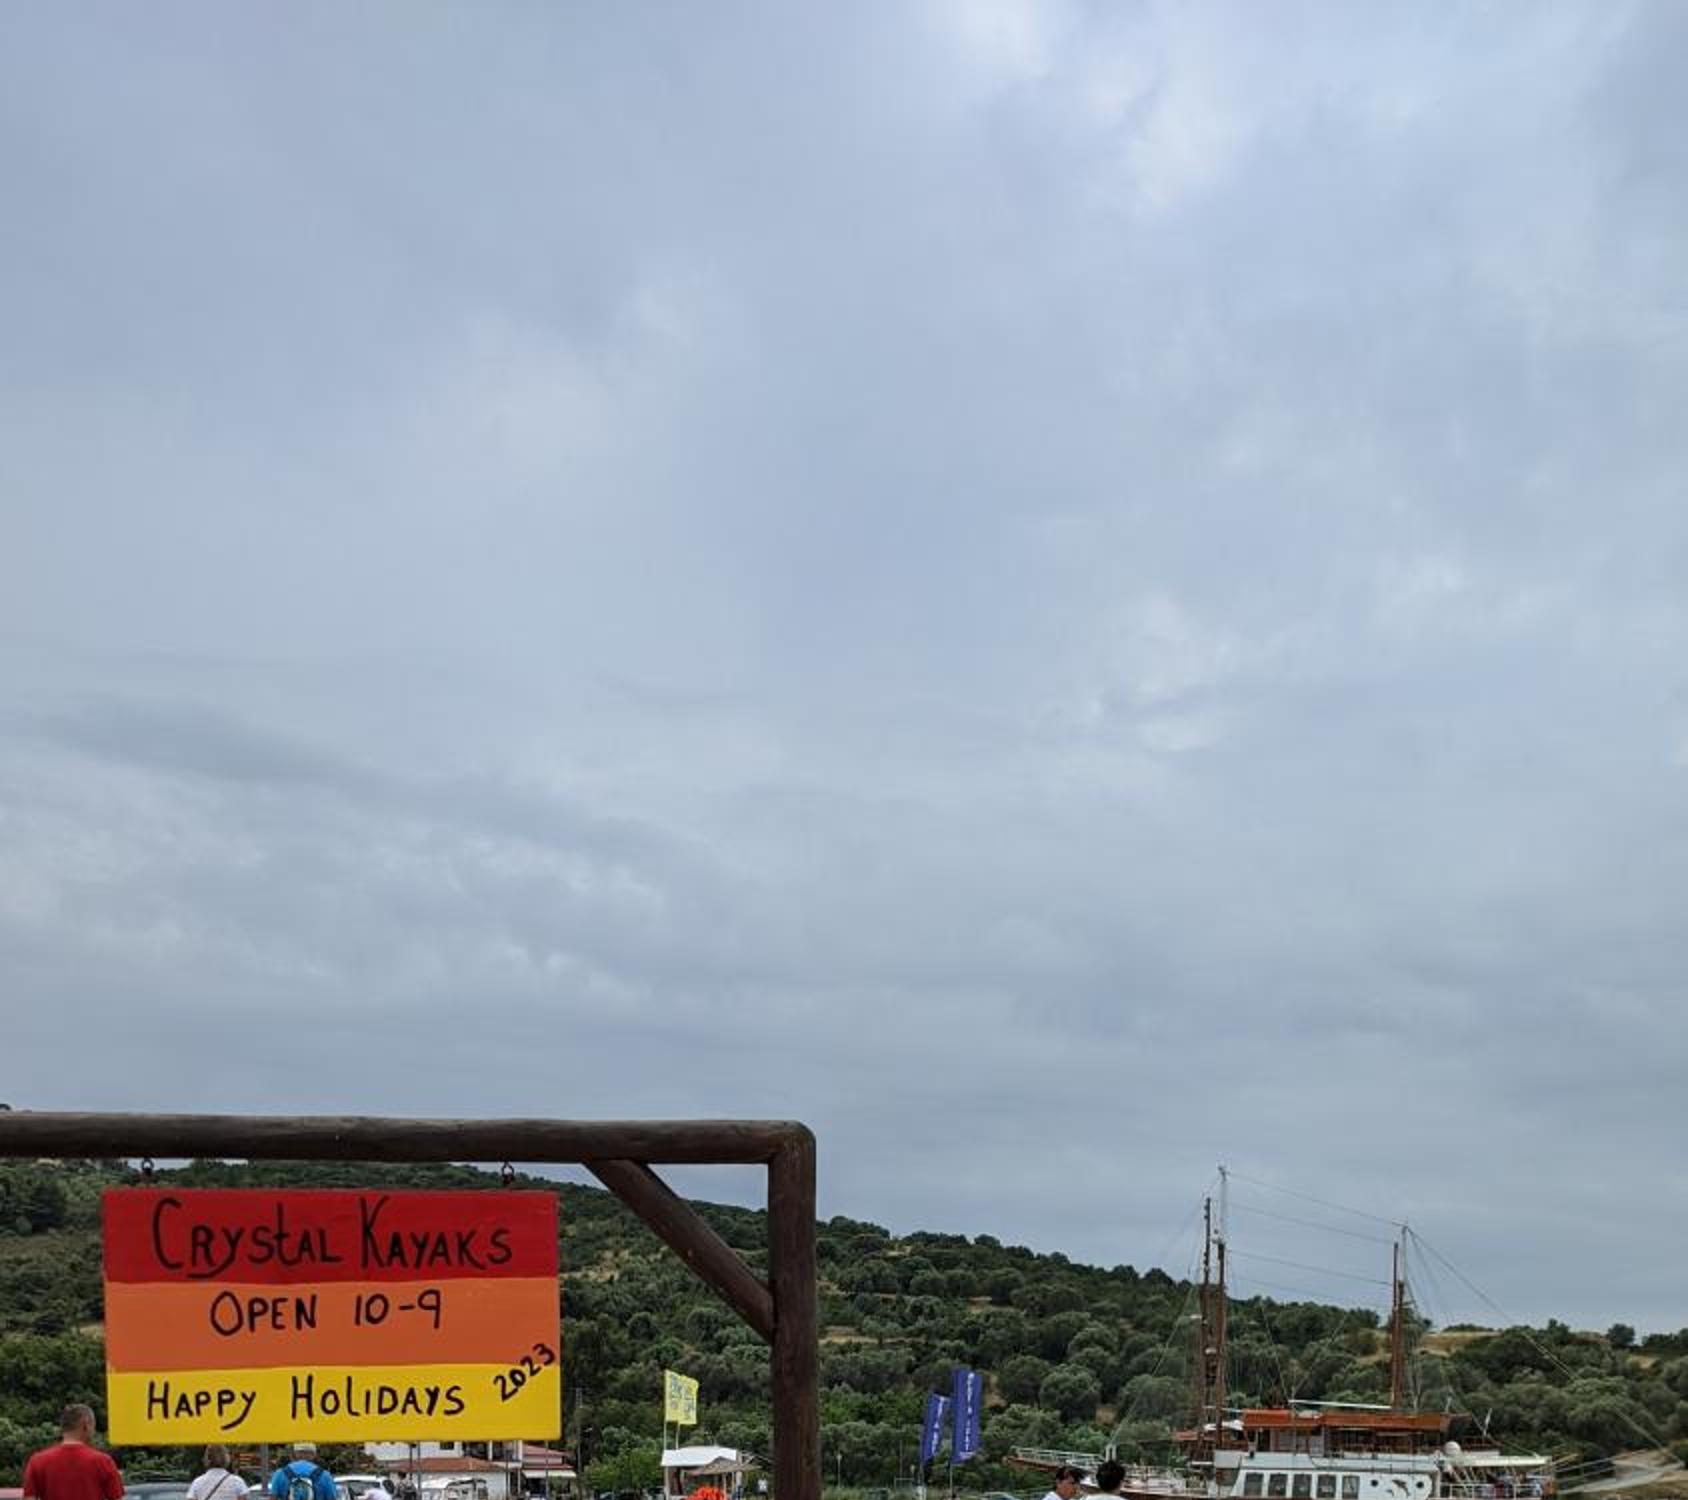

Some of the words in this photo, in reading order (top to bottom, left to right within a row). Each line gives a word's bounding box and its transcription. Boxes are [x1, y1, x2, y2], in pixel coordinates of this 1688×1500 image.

[359, 1195, 513, 1270] KAYAKS
[210, 1291, 317, 1336] OPEN
[354, 1289, 441, 1329] 10-9
[493, 1343, 556, 1402] 2023
[147, 1380, 256, 1430] HAPPY
[291, 1374, 465, 1420] HOLIDAYS
